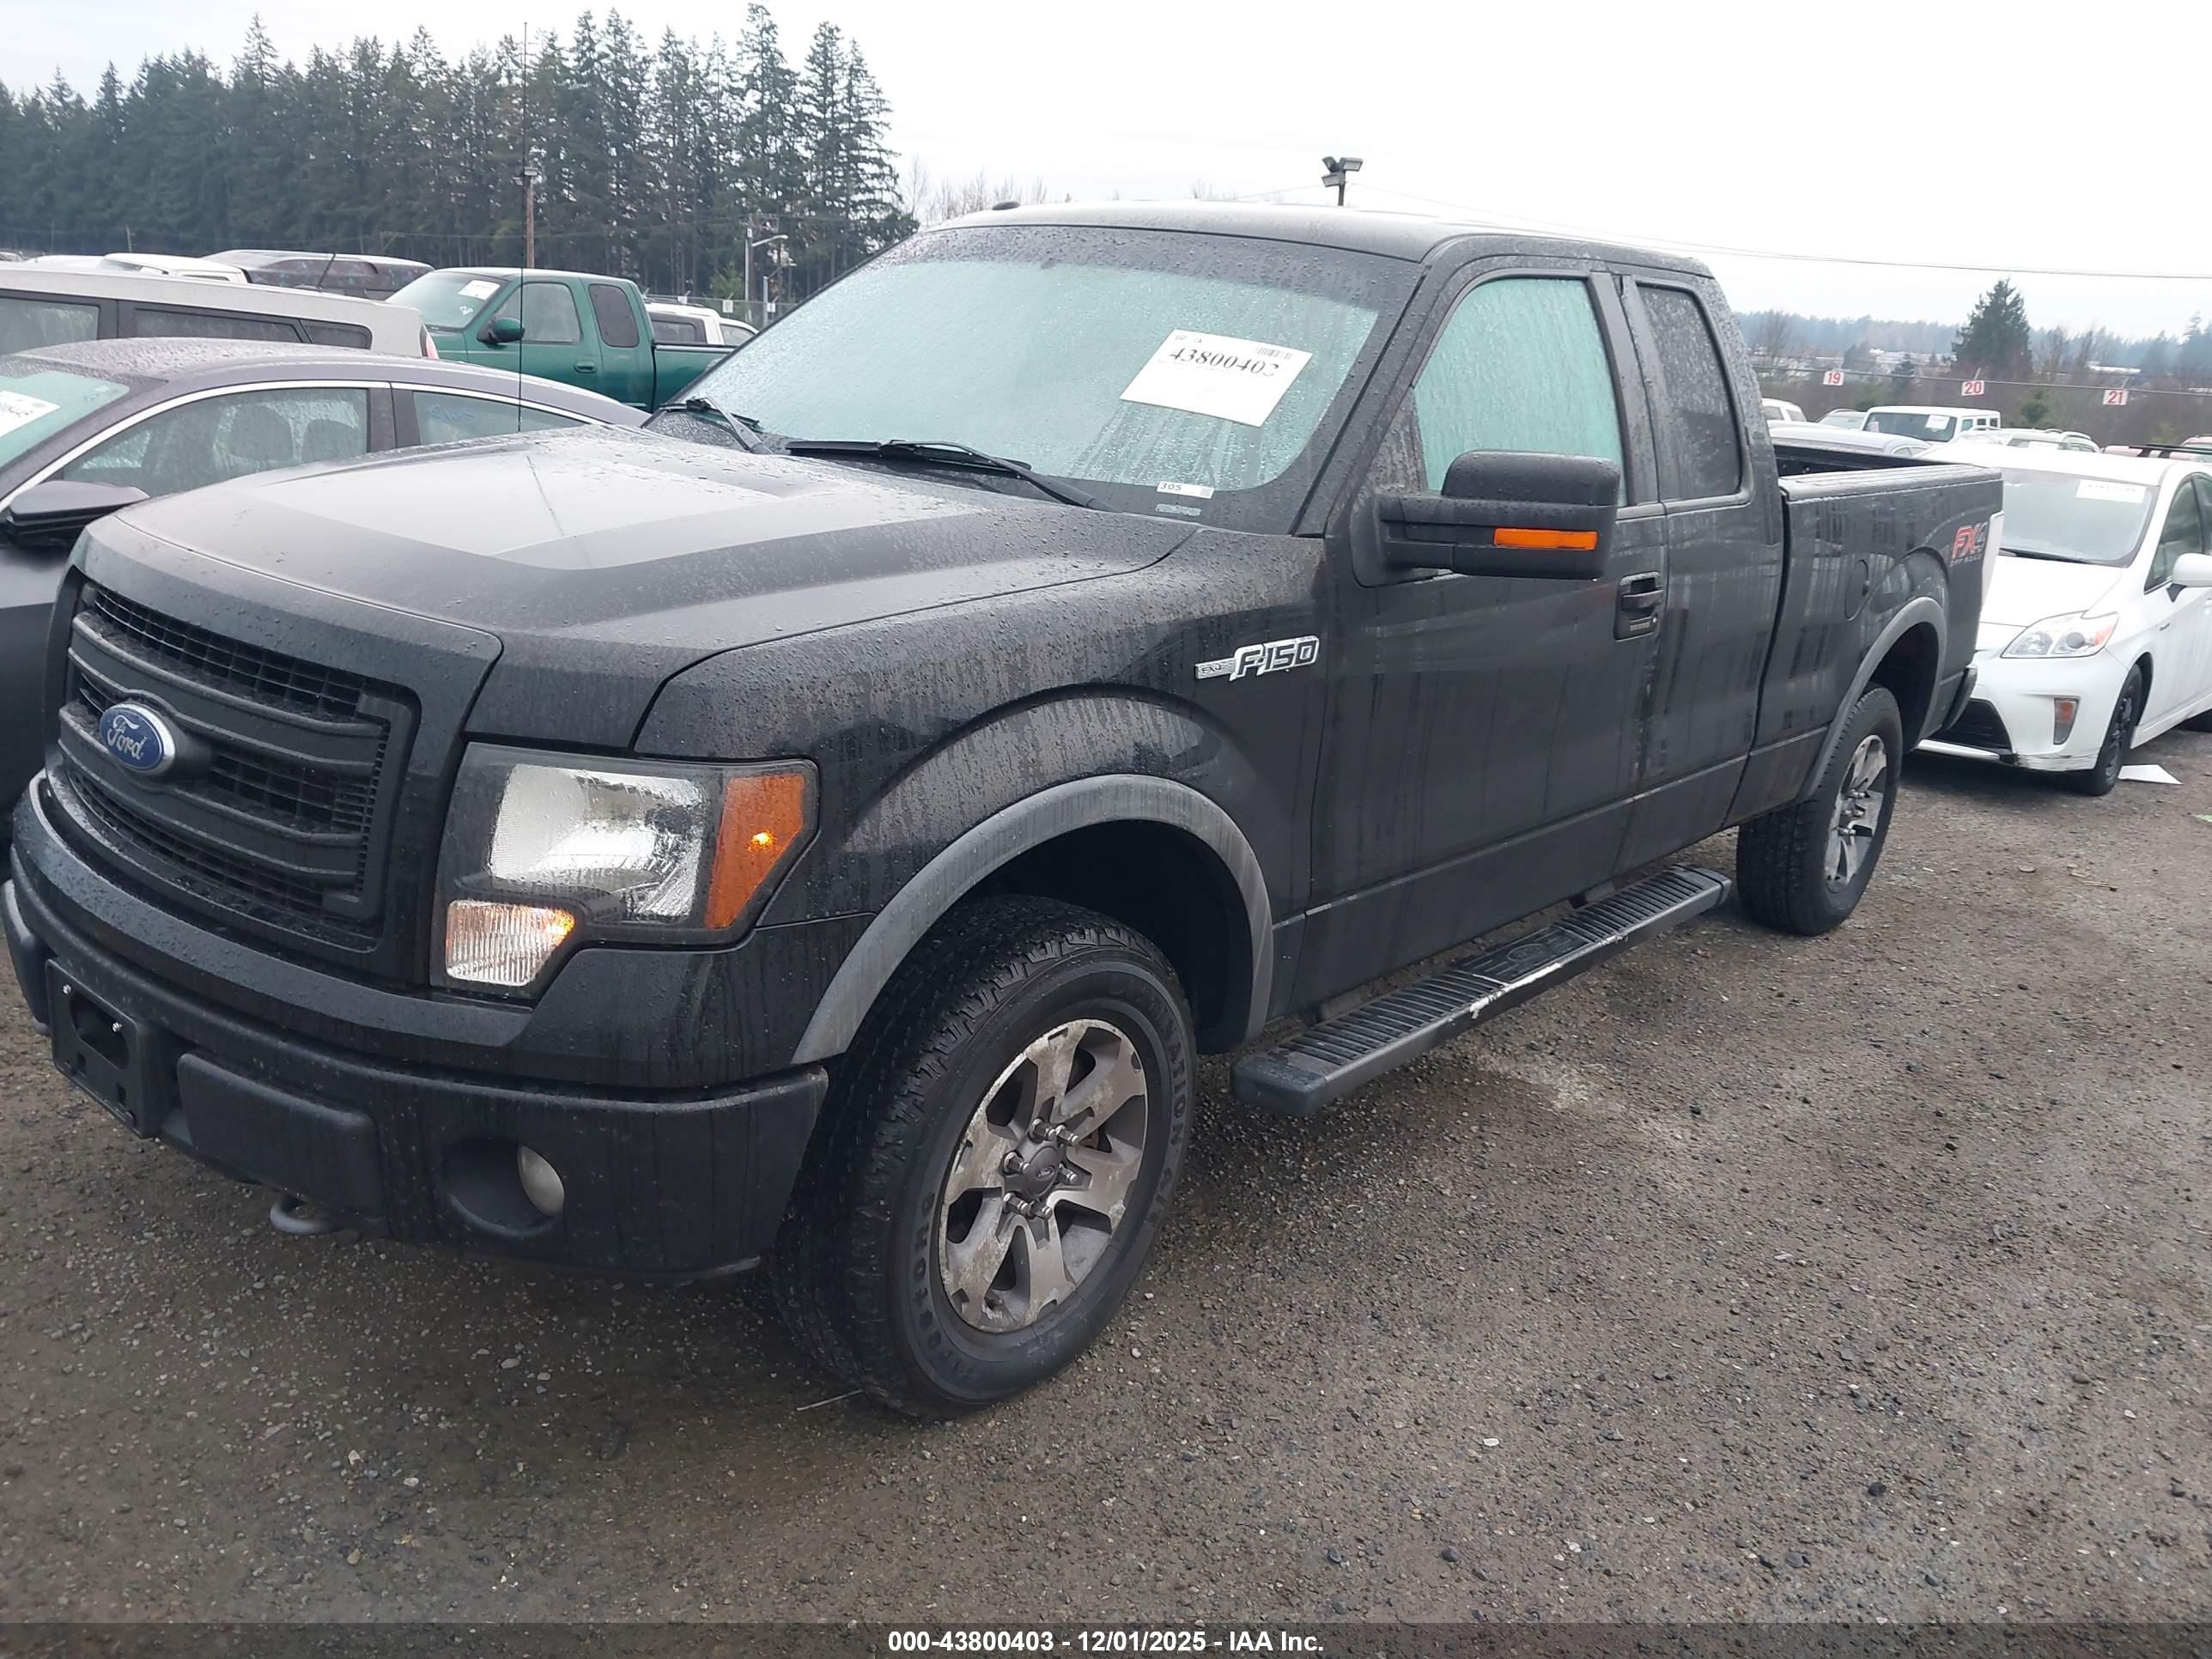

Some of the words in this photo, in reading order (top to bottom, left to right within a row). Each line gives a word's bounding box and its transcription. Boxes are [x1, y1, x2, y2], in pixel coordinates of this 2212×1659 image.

[1827, 372, 1842, 385] 19
[1963, 381, 1983, 395] 20
[2107, 391, 2124, 404] 21
[106, 714, 145, 760] Ford
